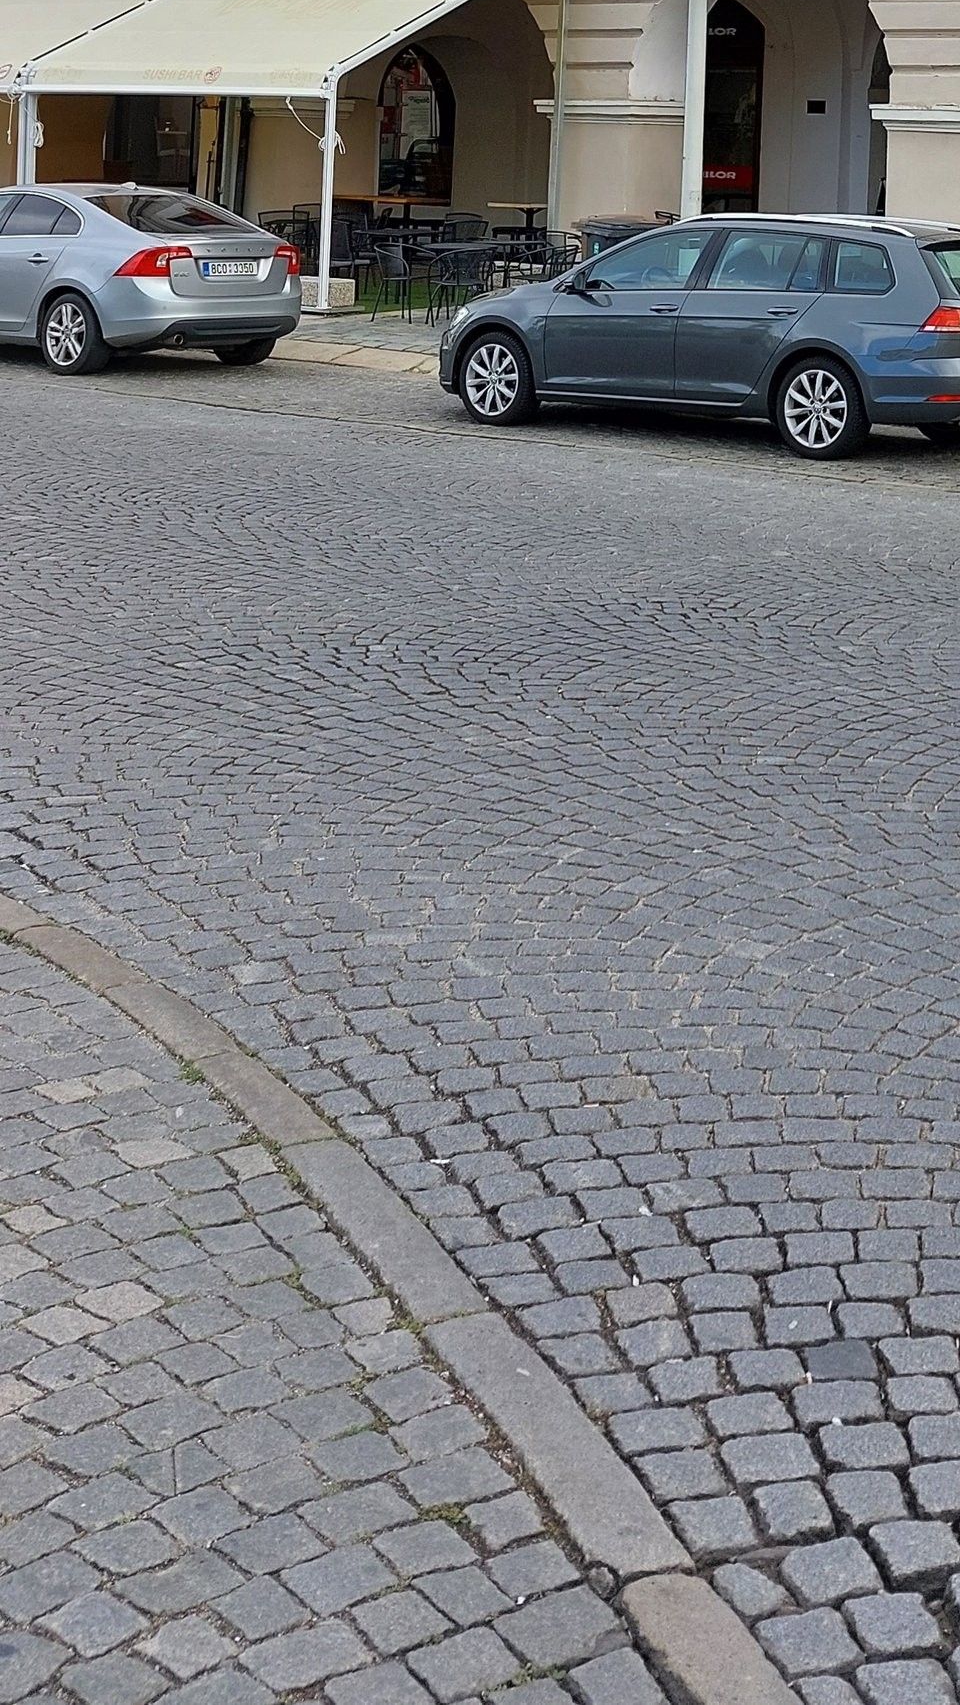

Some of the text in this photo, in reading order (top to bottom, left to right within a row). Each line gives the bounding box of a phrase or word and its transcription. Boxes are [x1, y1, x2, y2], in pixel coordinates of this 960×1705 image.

[708, 27, 737, 36] LOR
[142, 69, 203, 80] SUSHI BAR
[703, 170, 737, 179] ILOR
[233, 262, 254, 274] 3350
